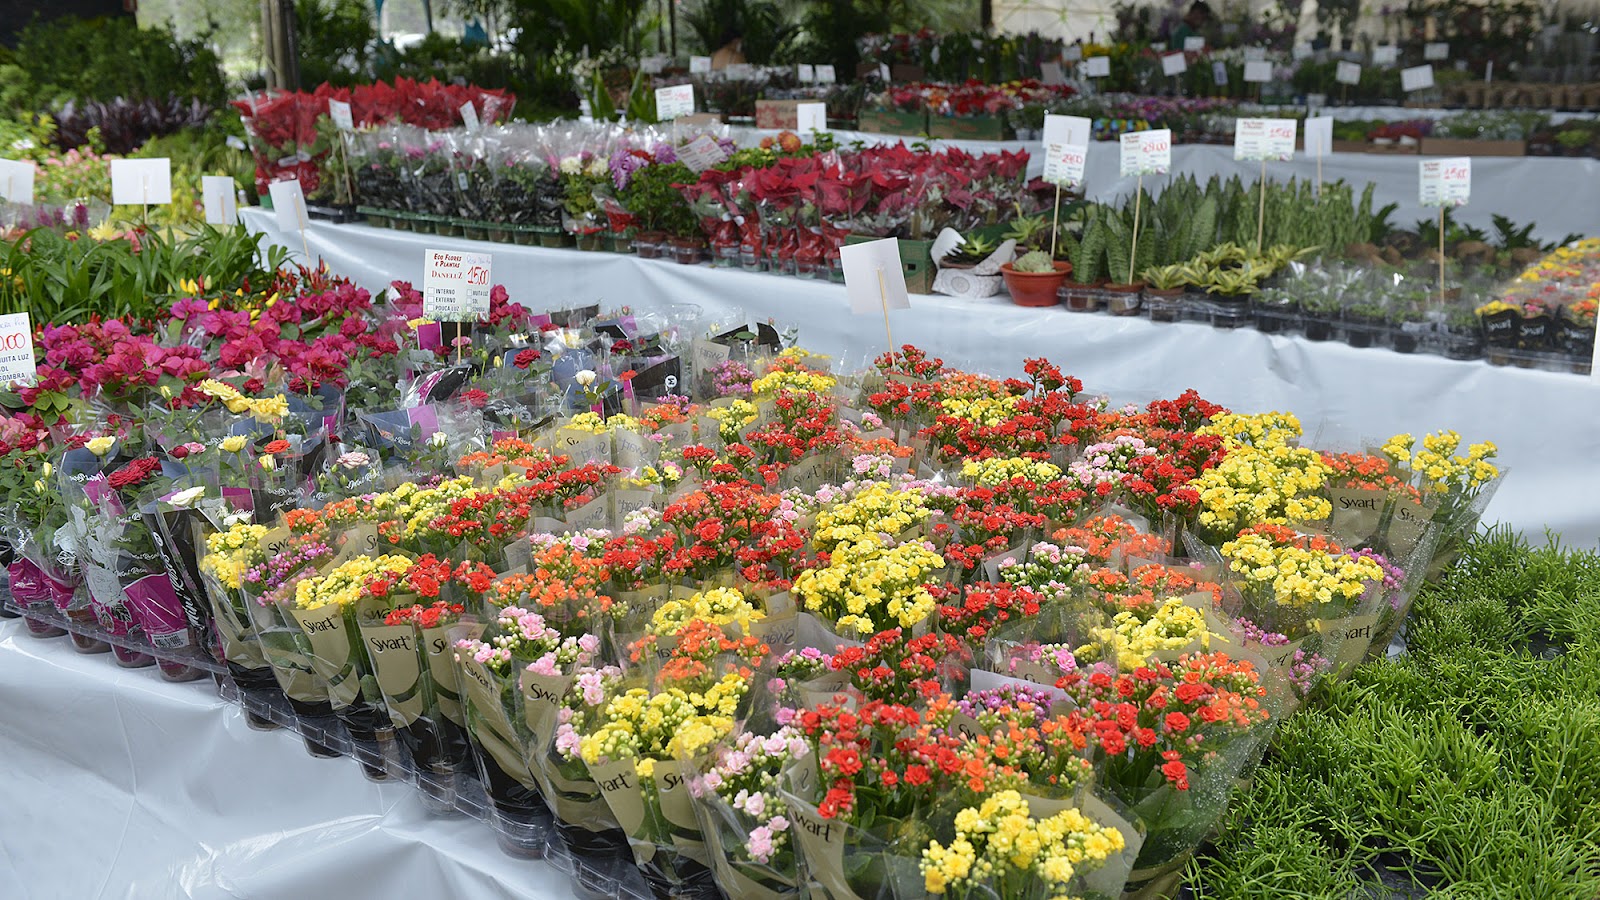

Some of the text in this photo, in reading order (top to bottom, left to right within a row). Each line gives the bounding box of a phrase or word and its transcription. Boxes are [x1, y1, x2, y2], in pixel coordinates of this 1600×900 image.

[17, 353, 30, 361] LUZ
[1339, 496, 1377, 511] Swart
[303, 616, 339, 634] Swart
[370, 635, 412, 652] Swart
